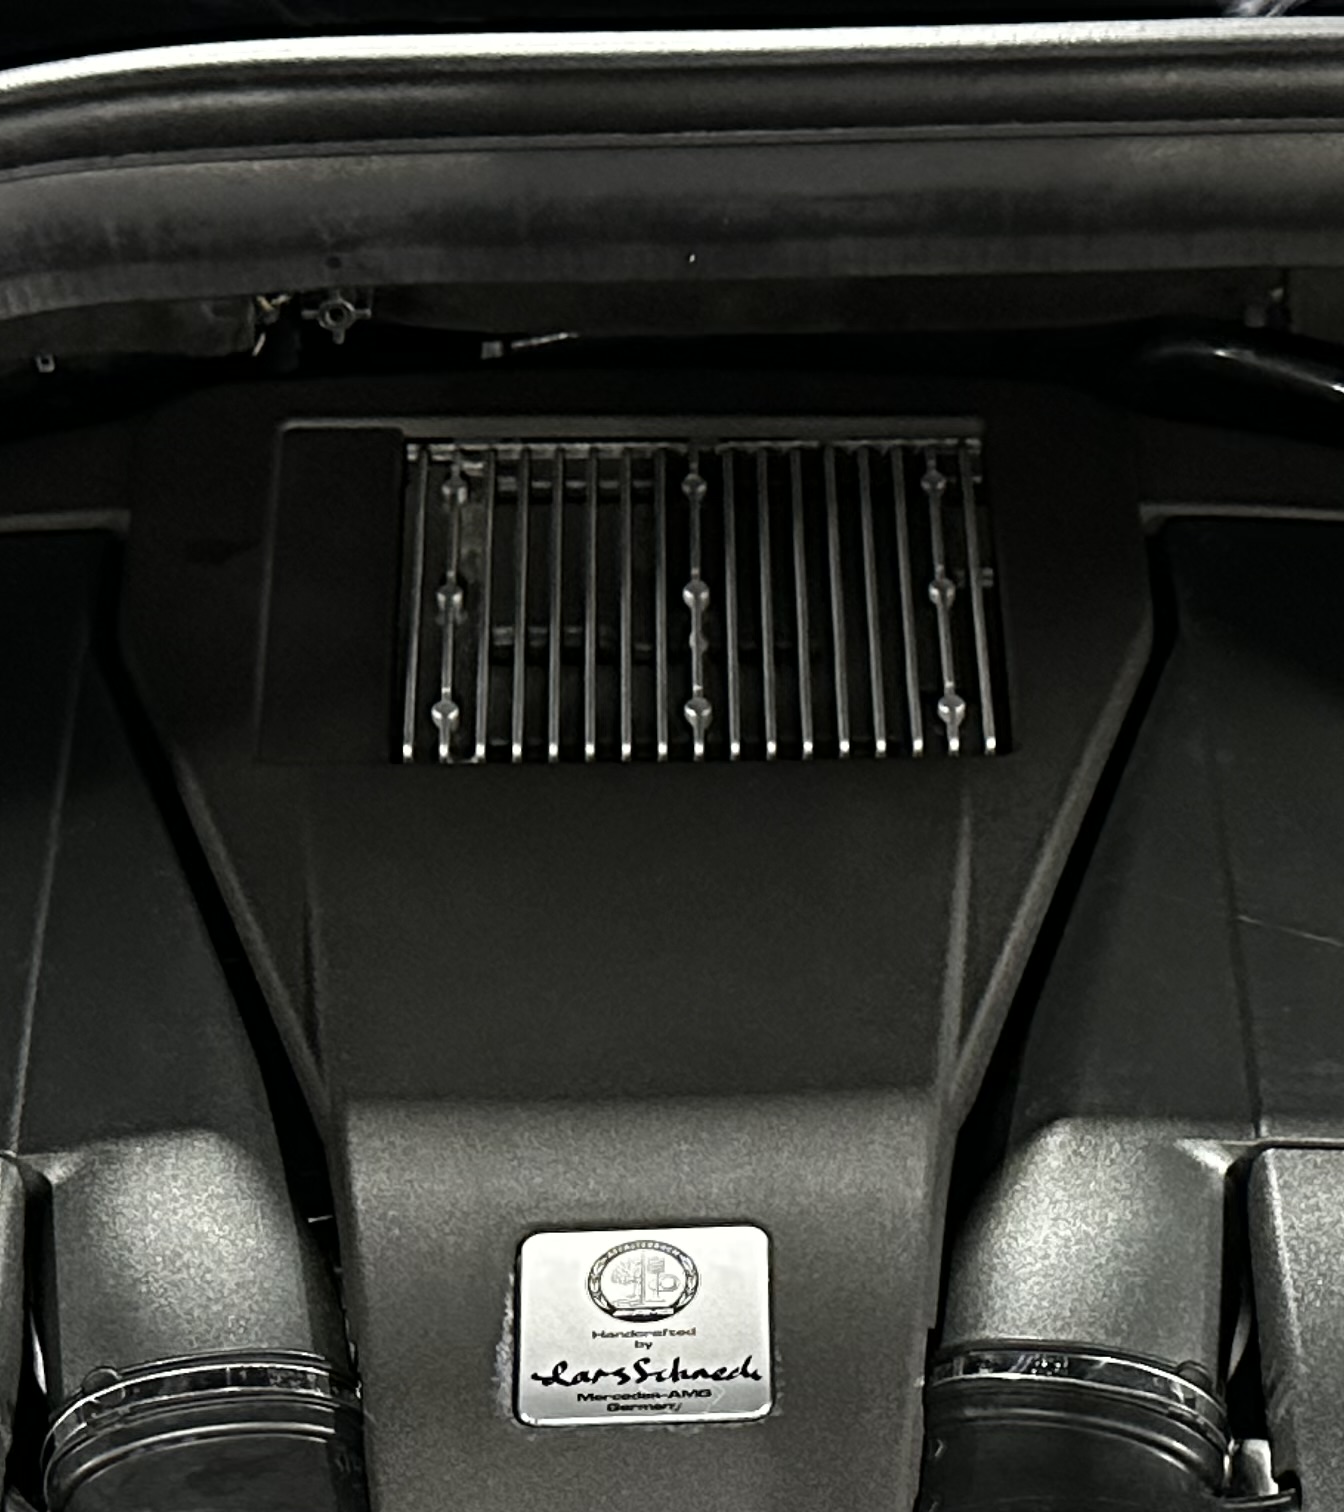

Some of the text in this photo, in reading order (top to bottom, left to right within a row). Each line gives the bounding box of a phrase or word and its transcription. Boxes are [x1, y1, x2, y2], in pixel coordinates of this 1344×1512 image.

[591, 1327, 697, 1340] Handcrafted
[634, 1340, 653, 1351] by
[577, 1388, 713, 1402] Mercedes-AMG
[606, 1402, 684, 1413] Germany
